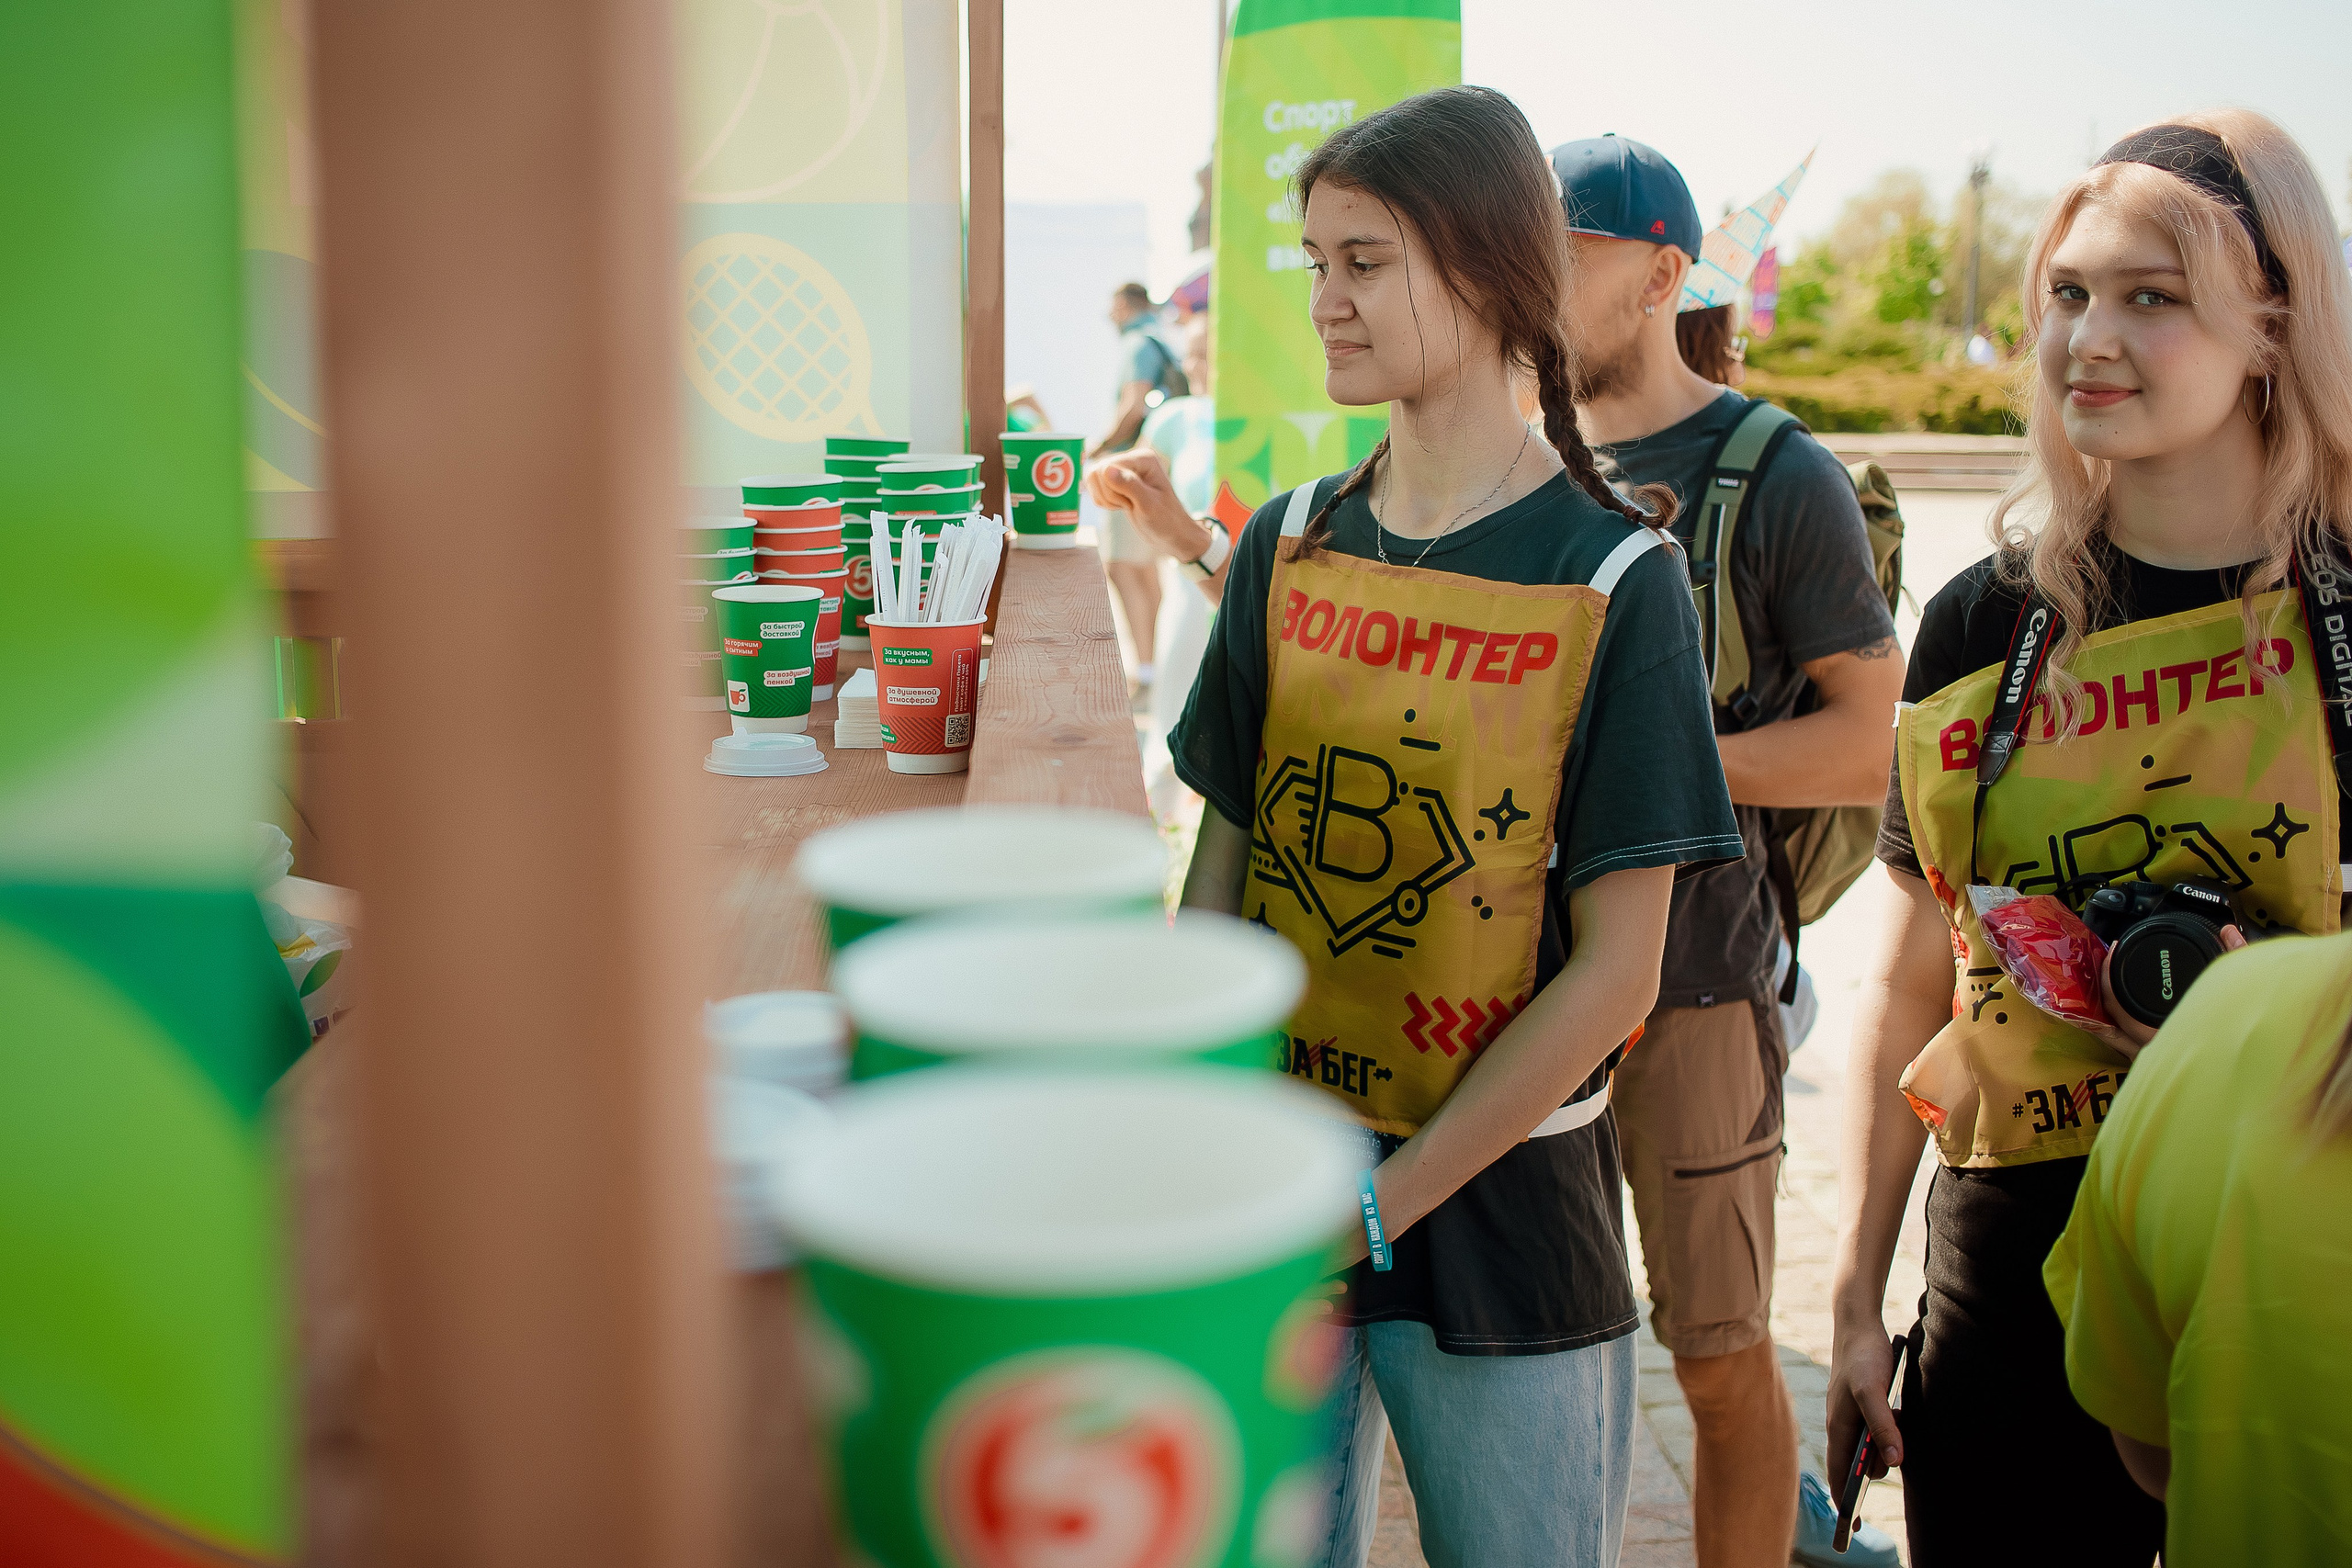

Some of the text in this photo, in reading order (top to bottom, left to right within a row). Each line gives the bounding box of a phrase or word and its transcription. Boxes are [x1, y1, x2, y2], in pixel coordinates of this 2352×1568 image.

[1264, 100, 1356, 133] Спорт
[2312, 553, 2341, 606] EOS
[773, 622, 803, 631] быстрой
[1280, 587, 1559, 685] ВОЛОНТЕР
[730, 640, 759, 649] горячим
[893, 649, 930, 658] вкусным,
[2005, 607, 2047, 705] Canon
[777, 668, 810, 679] воздушной
[897, 688, 937, 696] душевной
[1939, 637, 2294, 773] ВЛОНТЕР
[2182, 886, 2221, 904] Canon
[2161, 949, 2170, 1000] Canon
[1362, 1192, 1373, 1205] НАС
[1364, 1206, 1375, 1215] ИЗ
